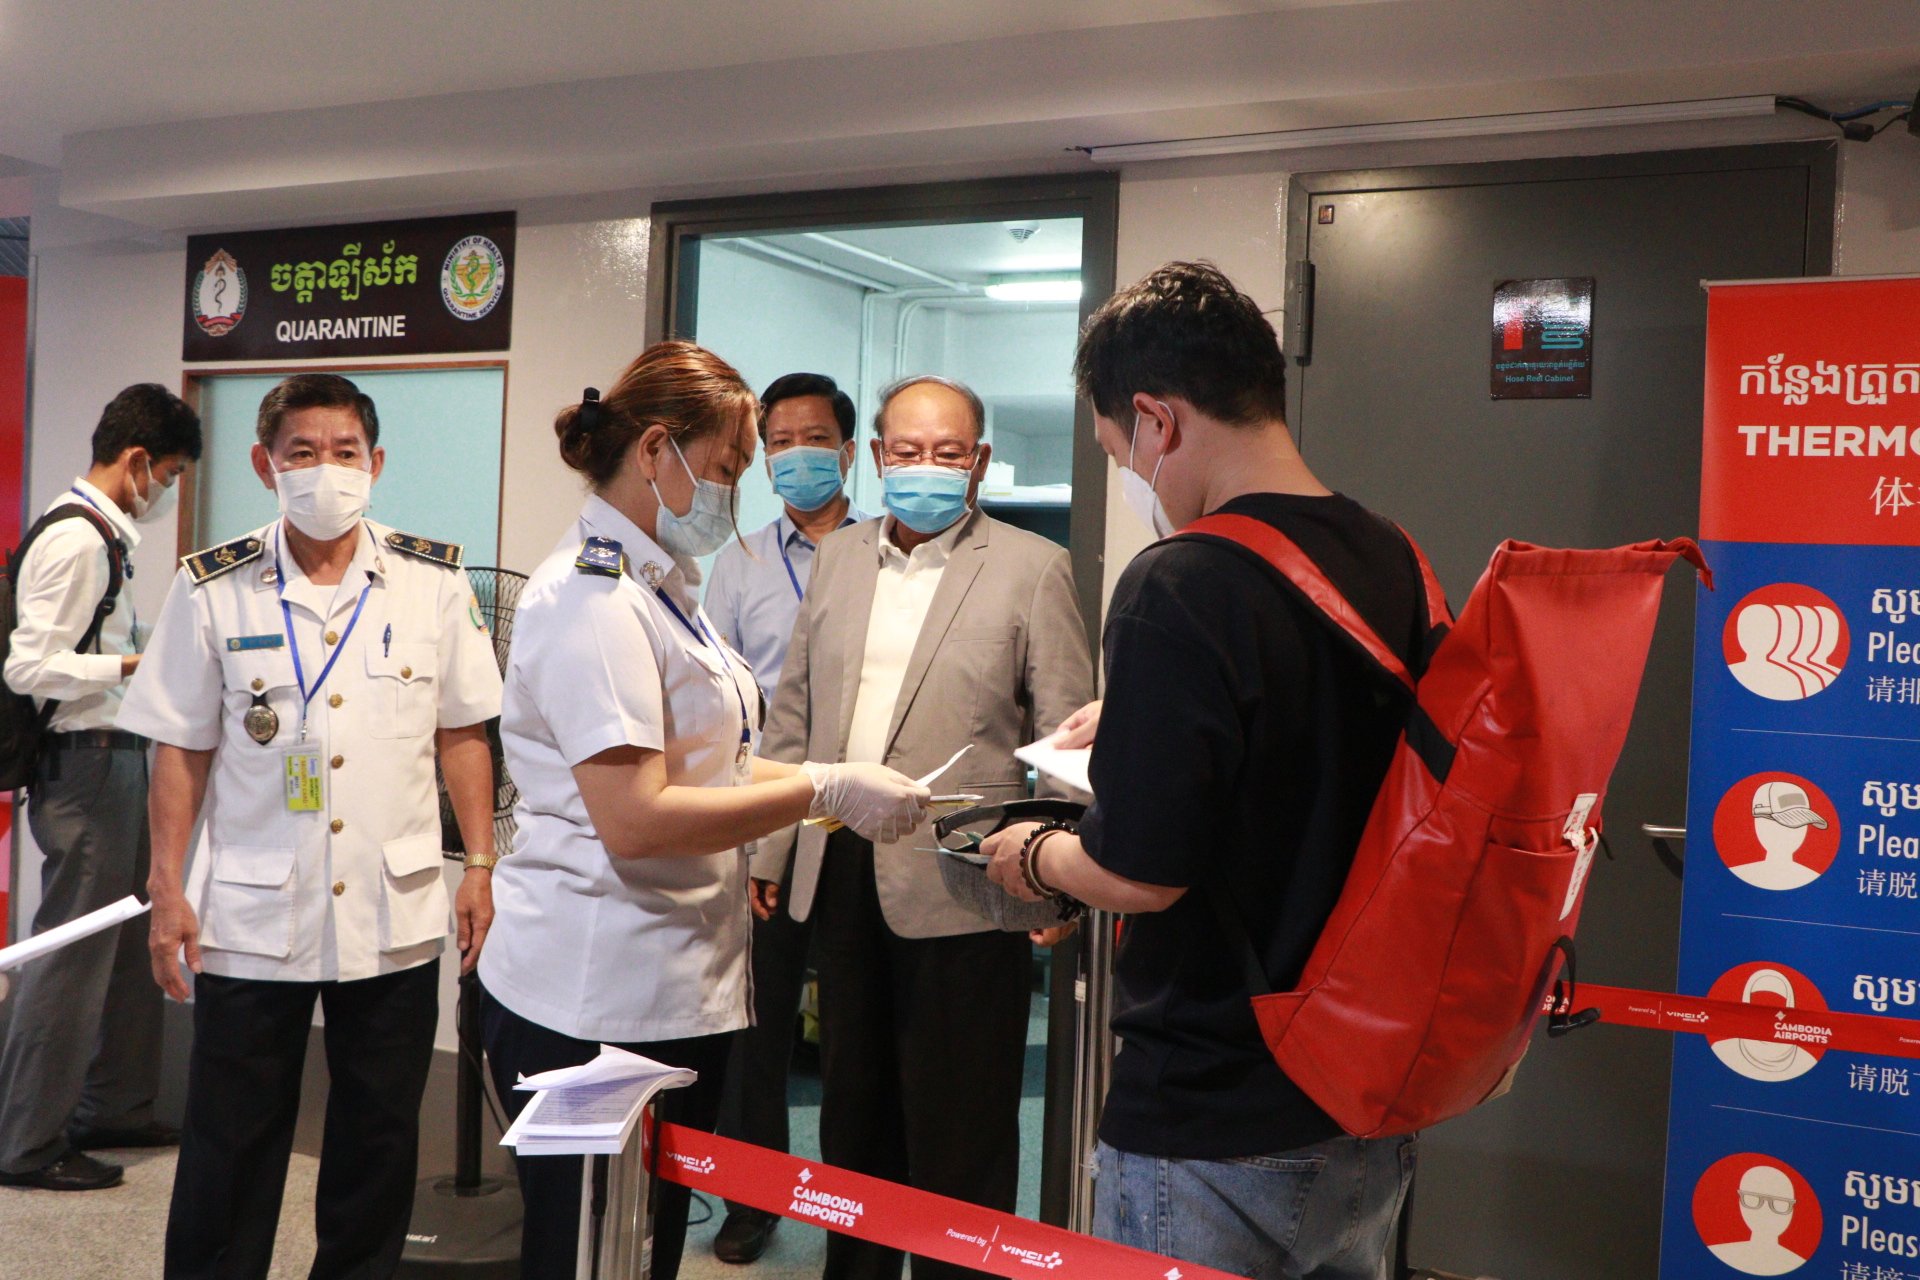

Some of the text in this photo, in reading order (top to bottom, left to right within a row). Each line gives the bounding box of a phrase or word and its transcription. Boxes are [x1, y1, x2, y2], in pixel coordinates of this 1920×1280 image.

[444, 238, 470, 271] MINISTRY
[483, 239, 503, 268] HEALTH
[442, 285, 502, 318] QUARANTINE SERVICE
[276, 315, 406, 342] QUARANTINE
[1505, 375, 1525, 383] Hose
[1544, 374, 1574, 382] Cabinet
[1869, 475, 1920, 517] 体
[1858, 823, 1919, 859] Plea
[1857, 868, 1918, 900] 请脱
[1666, 1011, 1695, 1019] VINCI
[1847, 1063, 1920, 1097] 请脱
[666, 1151, 700, 1167] VINCI
[946, 1228, 987, 1247] Powered by
[1001, 1244, 1042, 1261] VINCI
